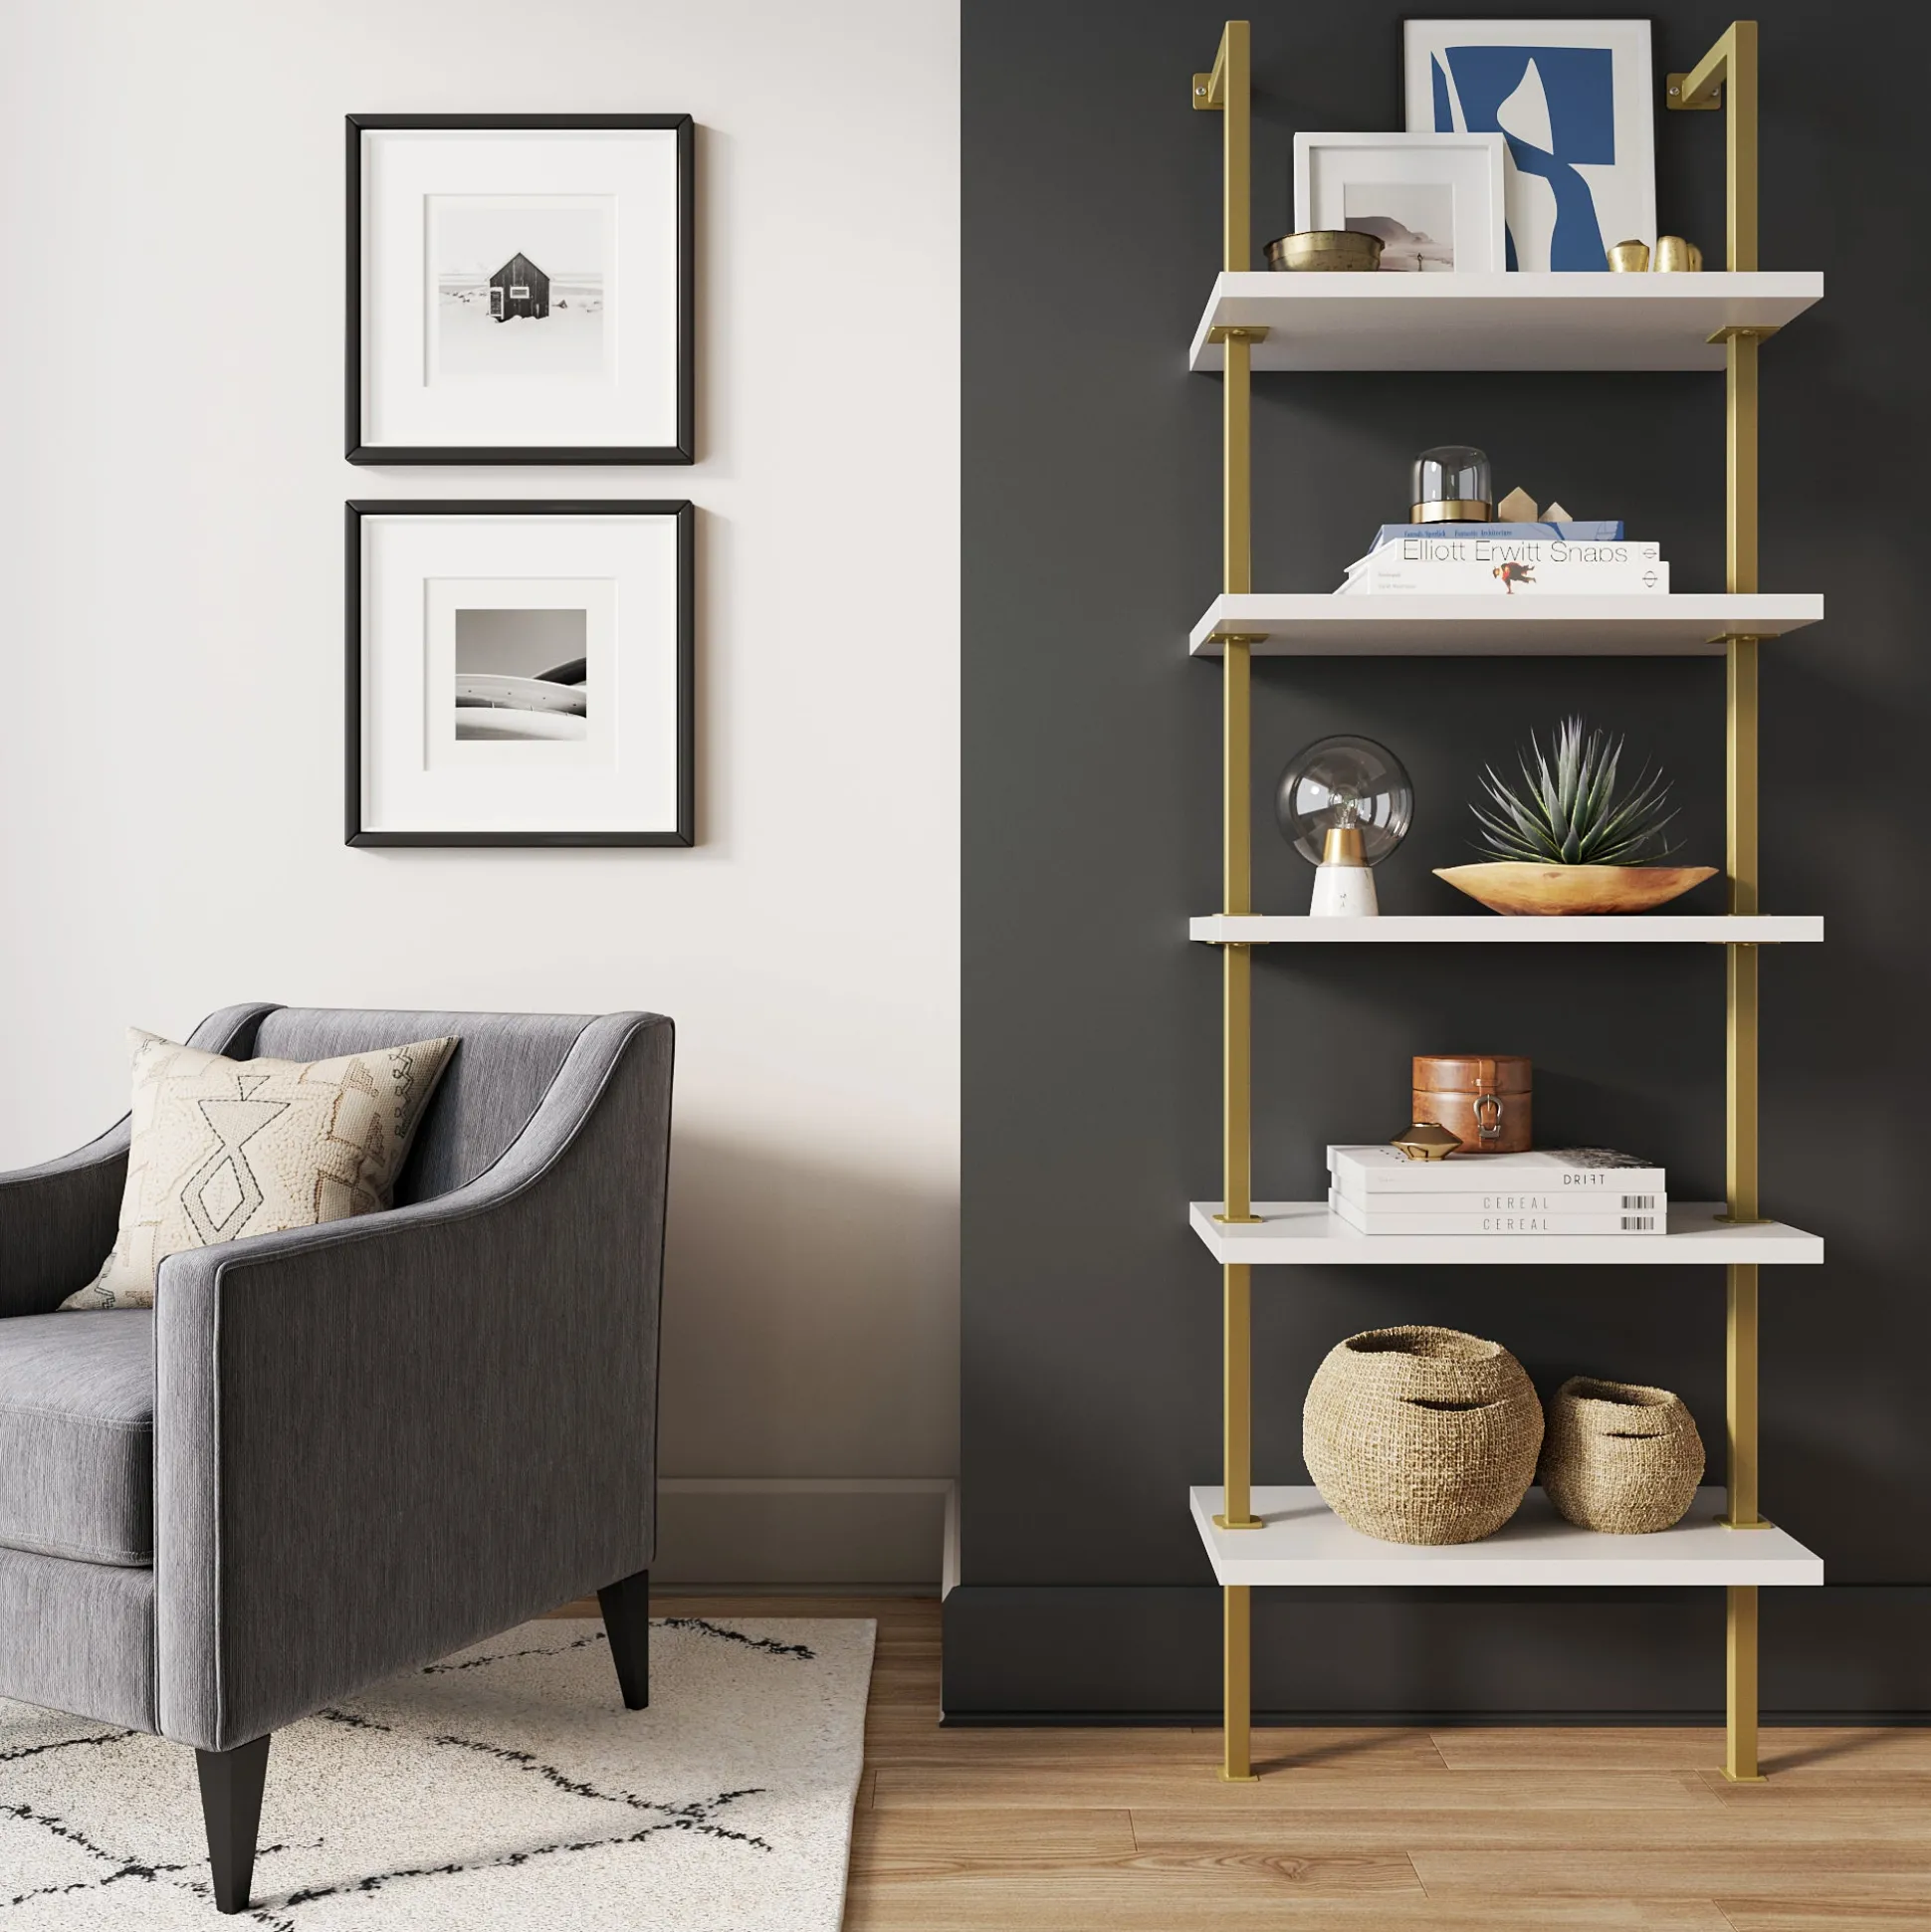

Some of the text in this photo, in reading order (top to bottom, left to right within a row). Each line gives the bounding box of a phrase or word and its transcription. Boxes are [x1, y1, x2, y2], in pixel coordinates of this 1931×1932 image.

[1403, 538, 1628, 562] Elliott Erwitt Snaps
[1563, 1174, 1606, 1185] DRIFT
[1483, 1196, 1549, 1209] CEREAL
[1483, 1218, 1549, 1230] CEREAL
